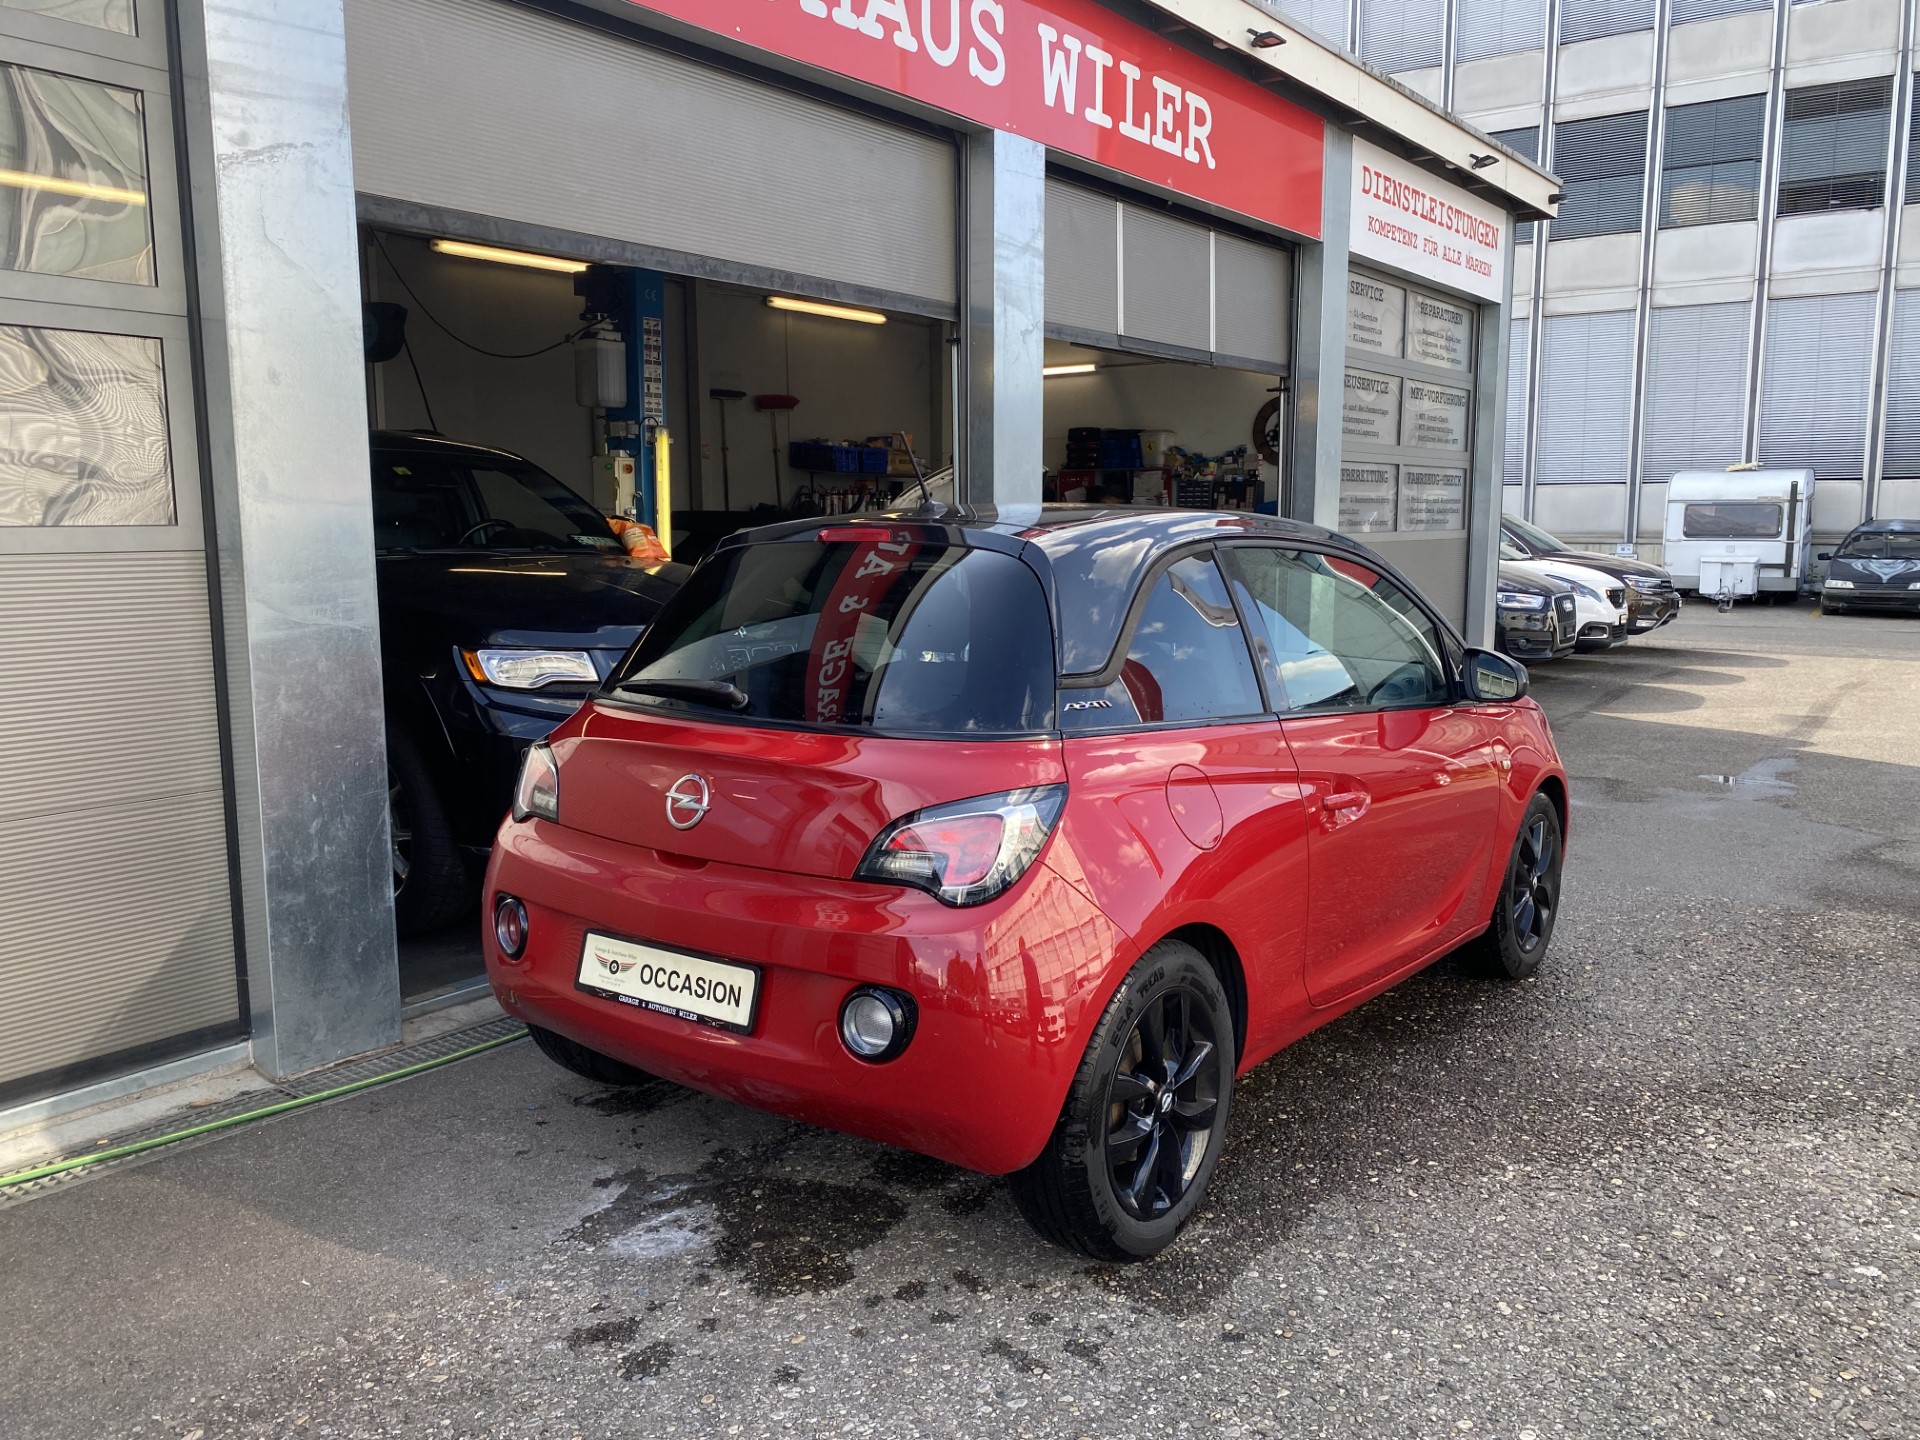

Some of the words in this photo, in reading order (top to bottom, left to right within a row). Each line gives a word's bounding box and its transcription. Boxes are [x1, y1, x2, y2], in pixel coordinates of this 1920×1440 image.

[1037, 22, 1216, 169] WILER
[1362, 165, 1499, 250] DIENSTLEISTUNGEN
[1367, 215, 1418, 249] KOMPETENZ
[1423, 235, 1438, 257] FÜR
[1442, 245, 1461, 266] ALLE
[1465, 255, 1492, 277] MARKEN
[1350, 280, 1384, 302] SERVICE
[1420, 302, 1464, 325] REPARATUREN
[619, 995, 639, 1006] GARAGE
[648, 1002, 677, 1016] AUTOHAUS
[679, 1010, 698, 1021] WILER
[640, 964, 742, 1008] OCCASION
